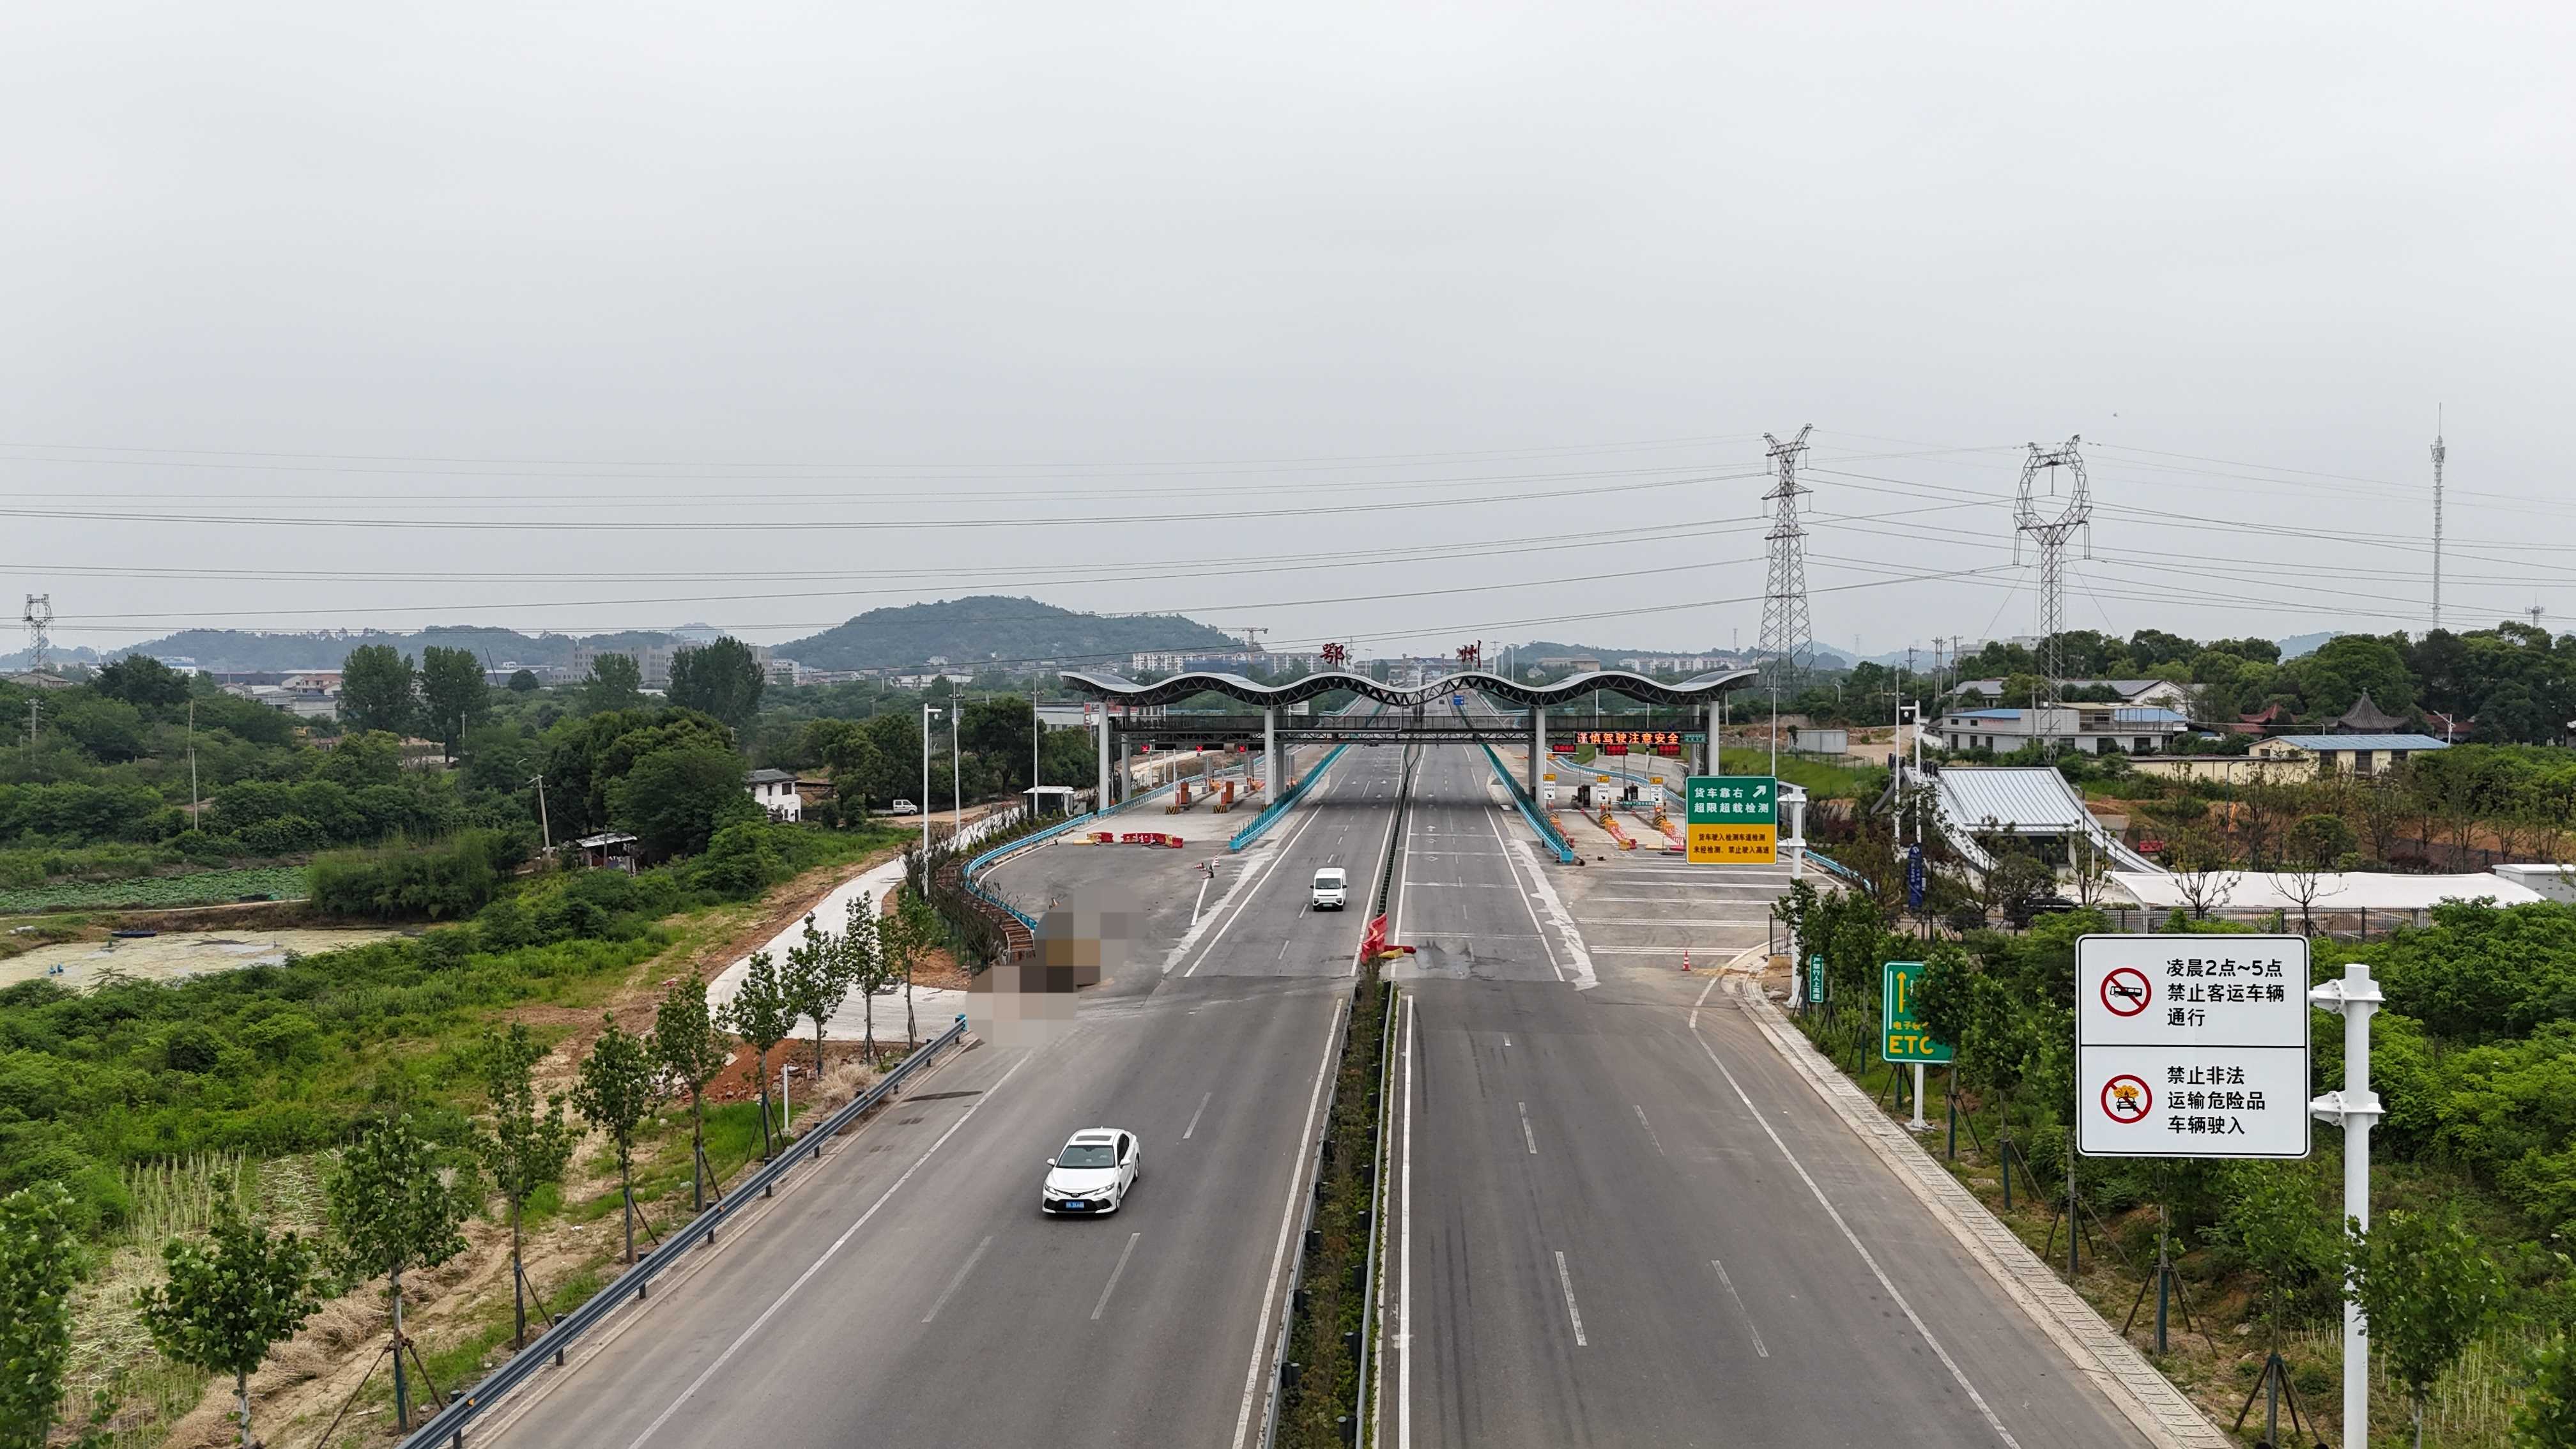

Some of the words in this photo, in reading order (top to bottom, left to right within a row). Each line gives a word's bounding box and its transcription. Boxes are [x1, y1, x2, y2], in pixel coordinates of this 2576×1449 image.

[1577, 732, 1679, 744] 谨慎驾驶注意安全
[1694, 787, 1744, 798] 货车靠右
[1694, 802, 1769, 813] 超限超载检测
[1698, 833, 1766, 841] 货车驶入检测车道检测
[2166, 959, 2283, 977] 凌晨2点~5点
[2168, 984, 2285, 1002] 禁止客运车辆
[2167, 1008, 2206, 1027] 通行
[1889, 1035, 1934, 1054] ETC
[2167, 1066, 2245, 1085] 禁止非法
[2168, 1091, 2266, 1110] 运输危险品
[2168, 1116, 2246, 1135] 车辆驶入
